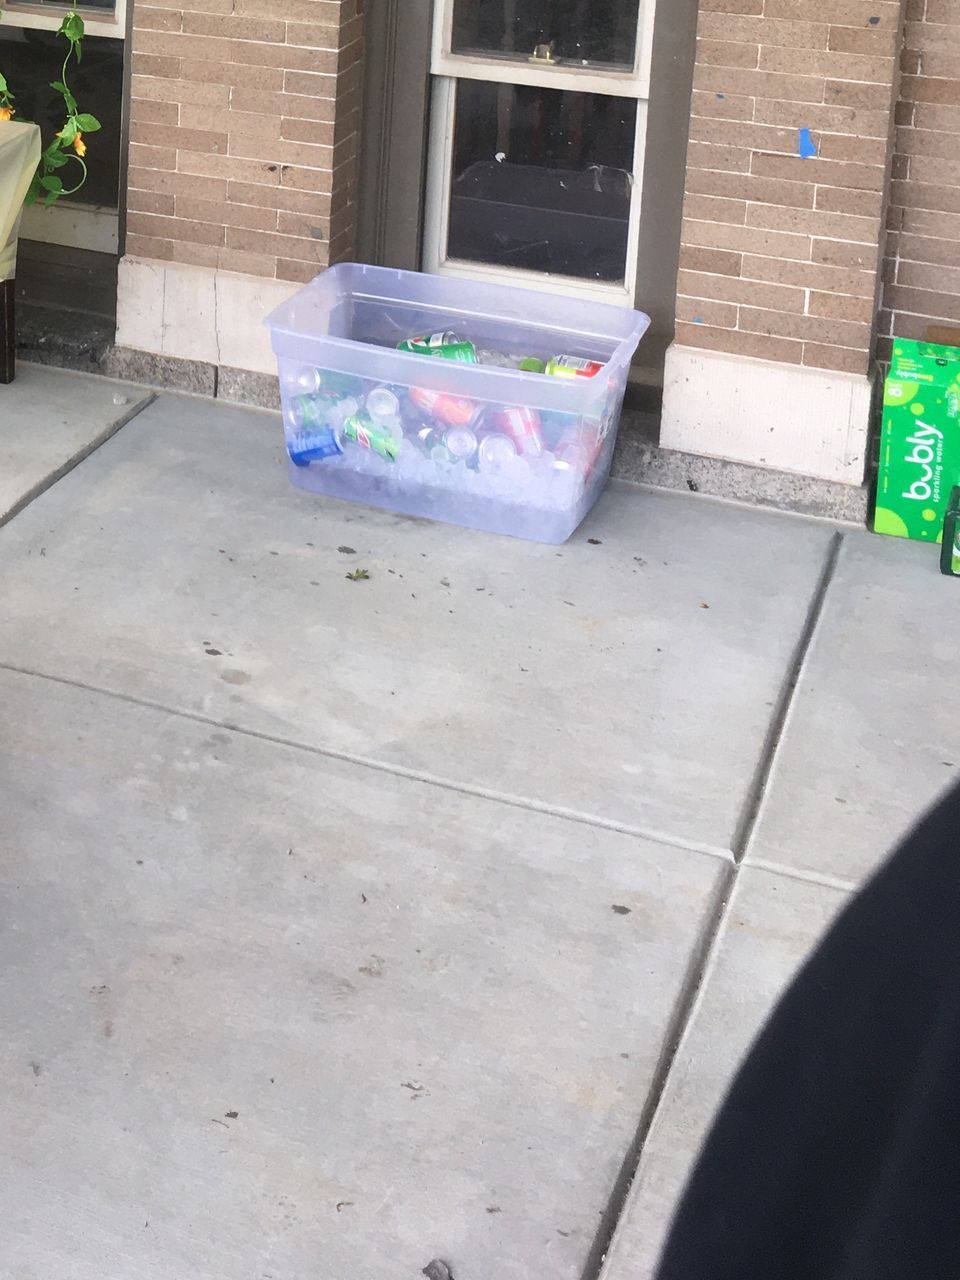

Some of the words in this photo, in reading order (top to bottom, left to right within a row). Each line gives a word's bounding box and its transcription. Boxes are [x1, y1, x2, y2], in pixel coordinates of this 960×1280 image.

[902, 419, 944, 501] bubly
[935, 436, 944, 464] water
[933, 464, 943, 503] sparkling
